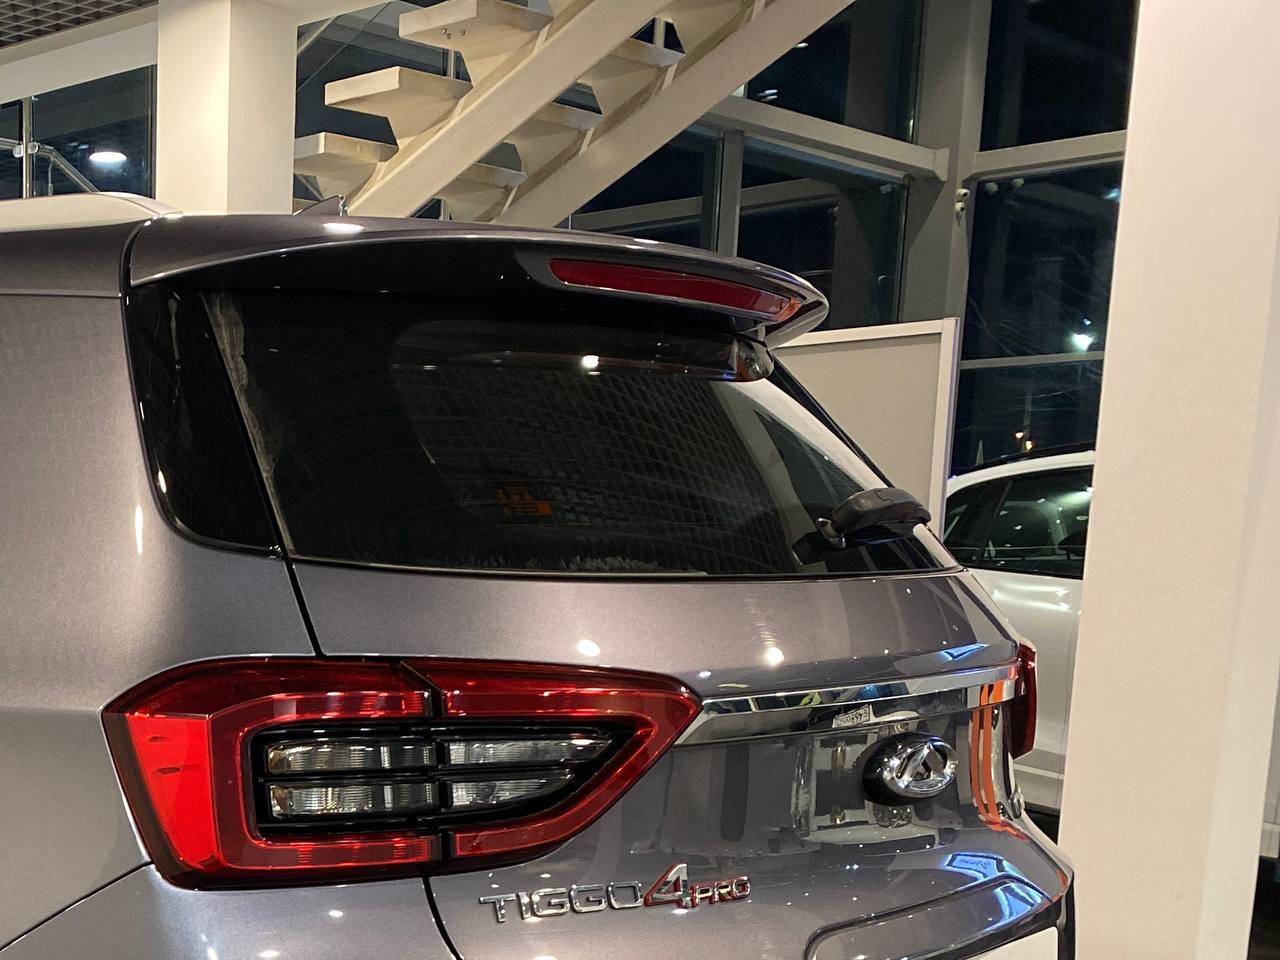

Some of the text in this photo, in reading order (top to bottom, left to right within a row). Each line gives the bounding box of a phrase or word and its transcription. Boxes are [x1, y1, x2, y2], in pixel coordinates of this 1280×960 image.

[479, 863, 751, 923] TIGGO 4 PRO
